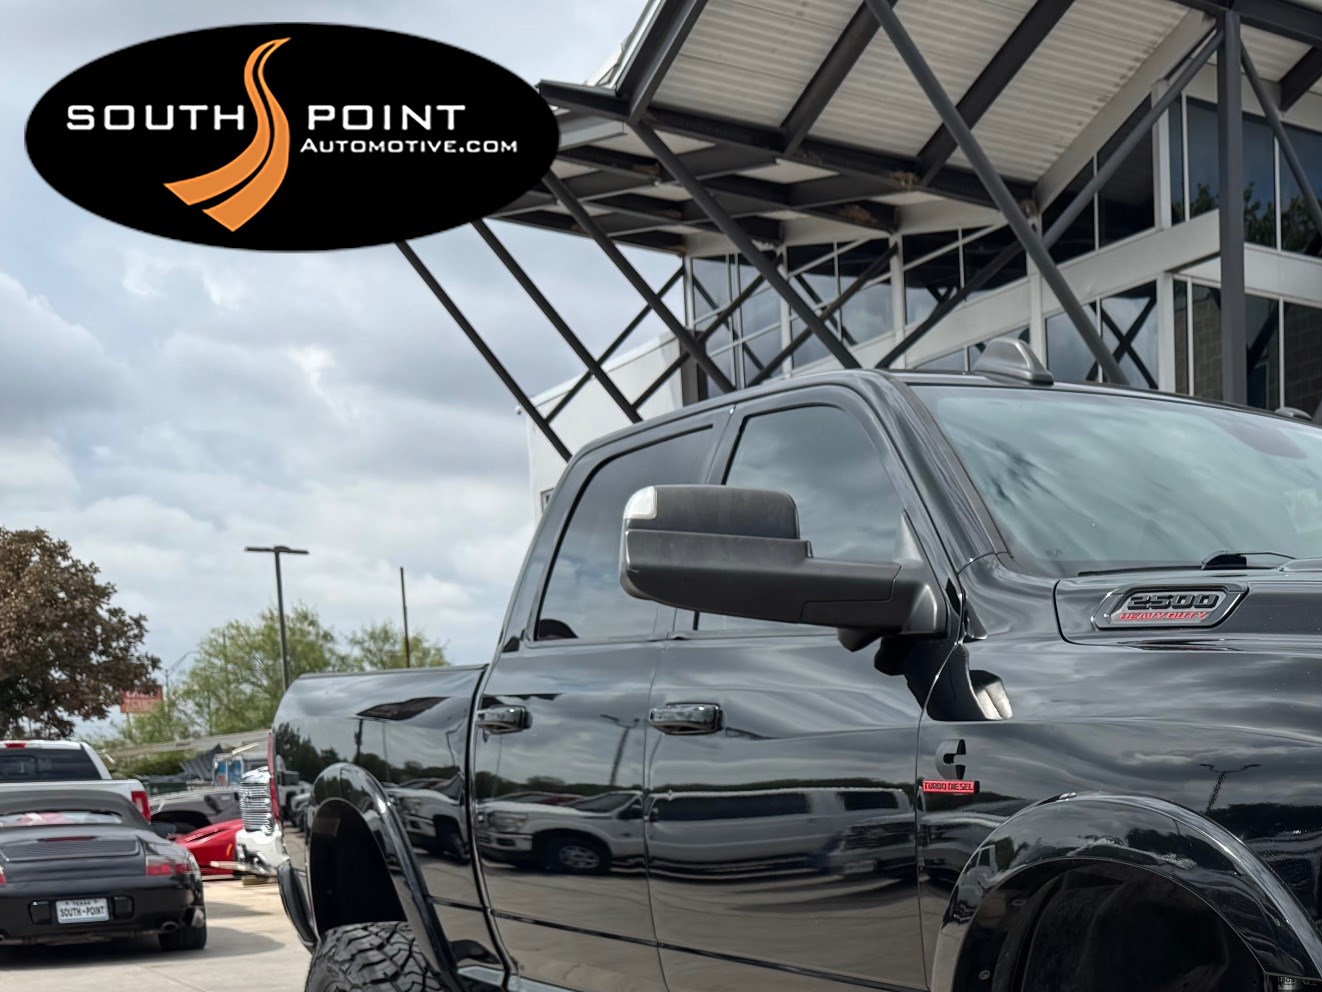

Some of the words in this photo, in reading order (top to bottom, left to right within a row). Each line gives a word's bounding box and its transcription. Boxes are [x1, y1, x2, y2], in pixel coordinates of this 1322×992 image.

[1127, 594, 1219, 610] 2500
[1120, 612, 1167, 620] HEAVY
[1167, 611, 1208, 619] DUTY
